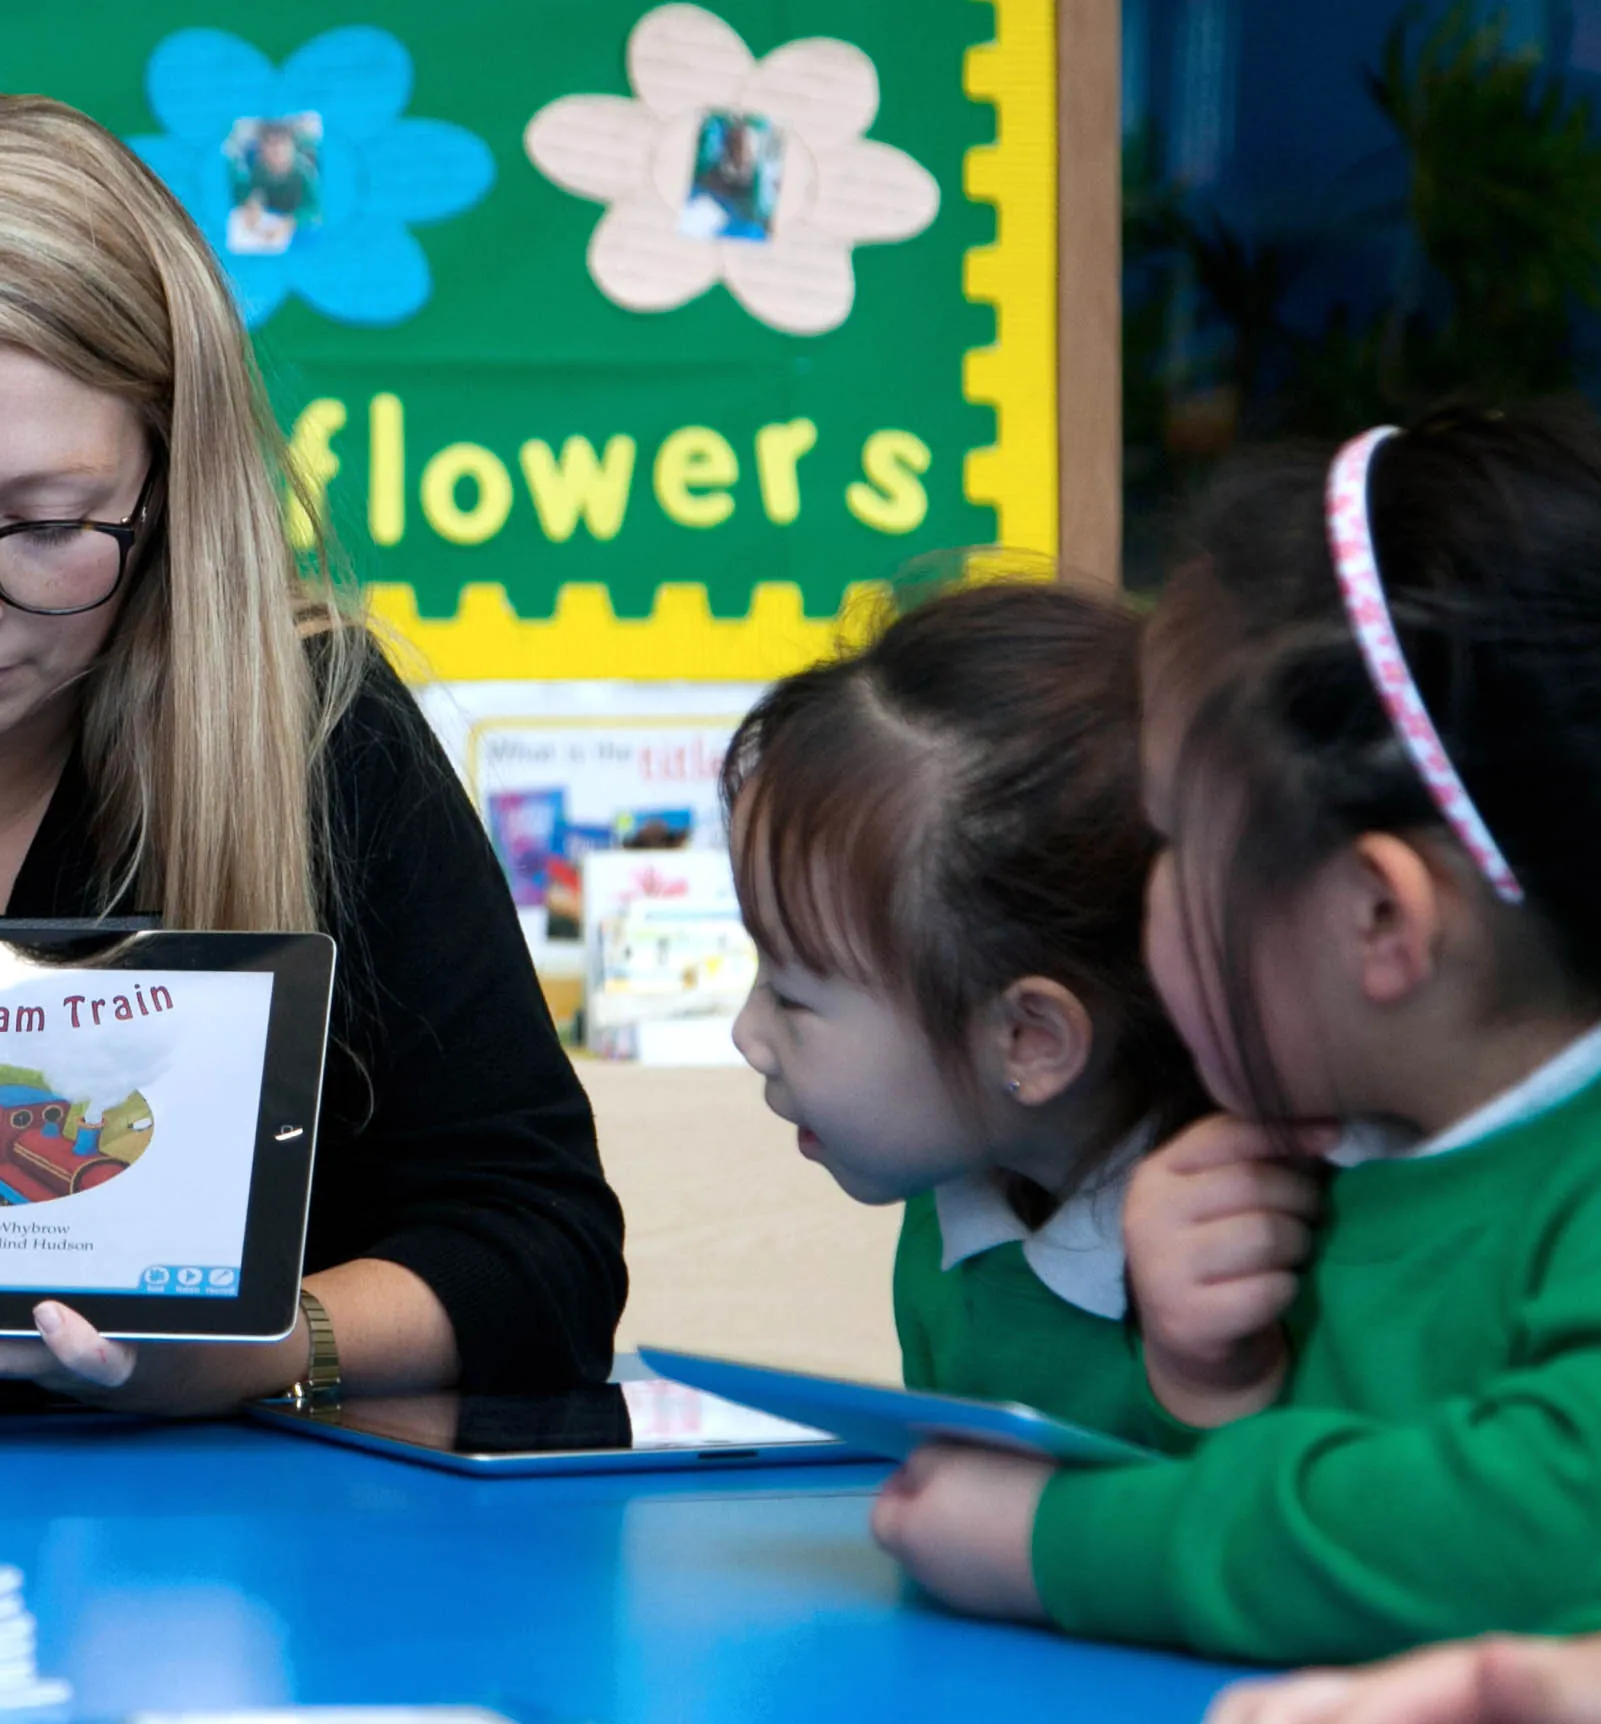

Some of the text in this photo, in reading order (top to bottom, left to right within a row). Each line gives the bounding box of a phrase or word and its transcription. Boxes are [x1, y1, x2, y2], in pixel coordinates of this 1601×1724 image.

[286, 392, 932, 548] flowers
[63, 983, 174, 1028] Train
[33, 1238, 94, 1251] Hudson
